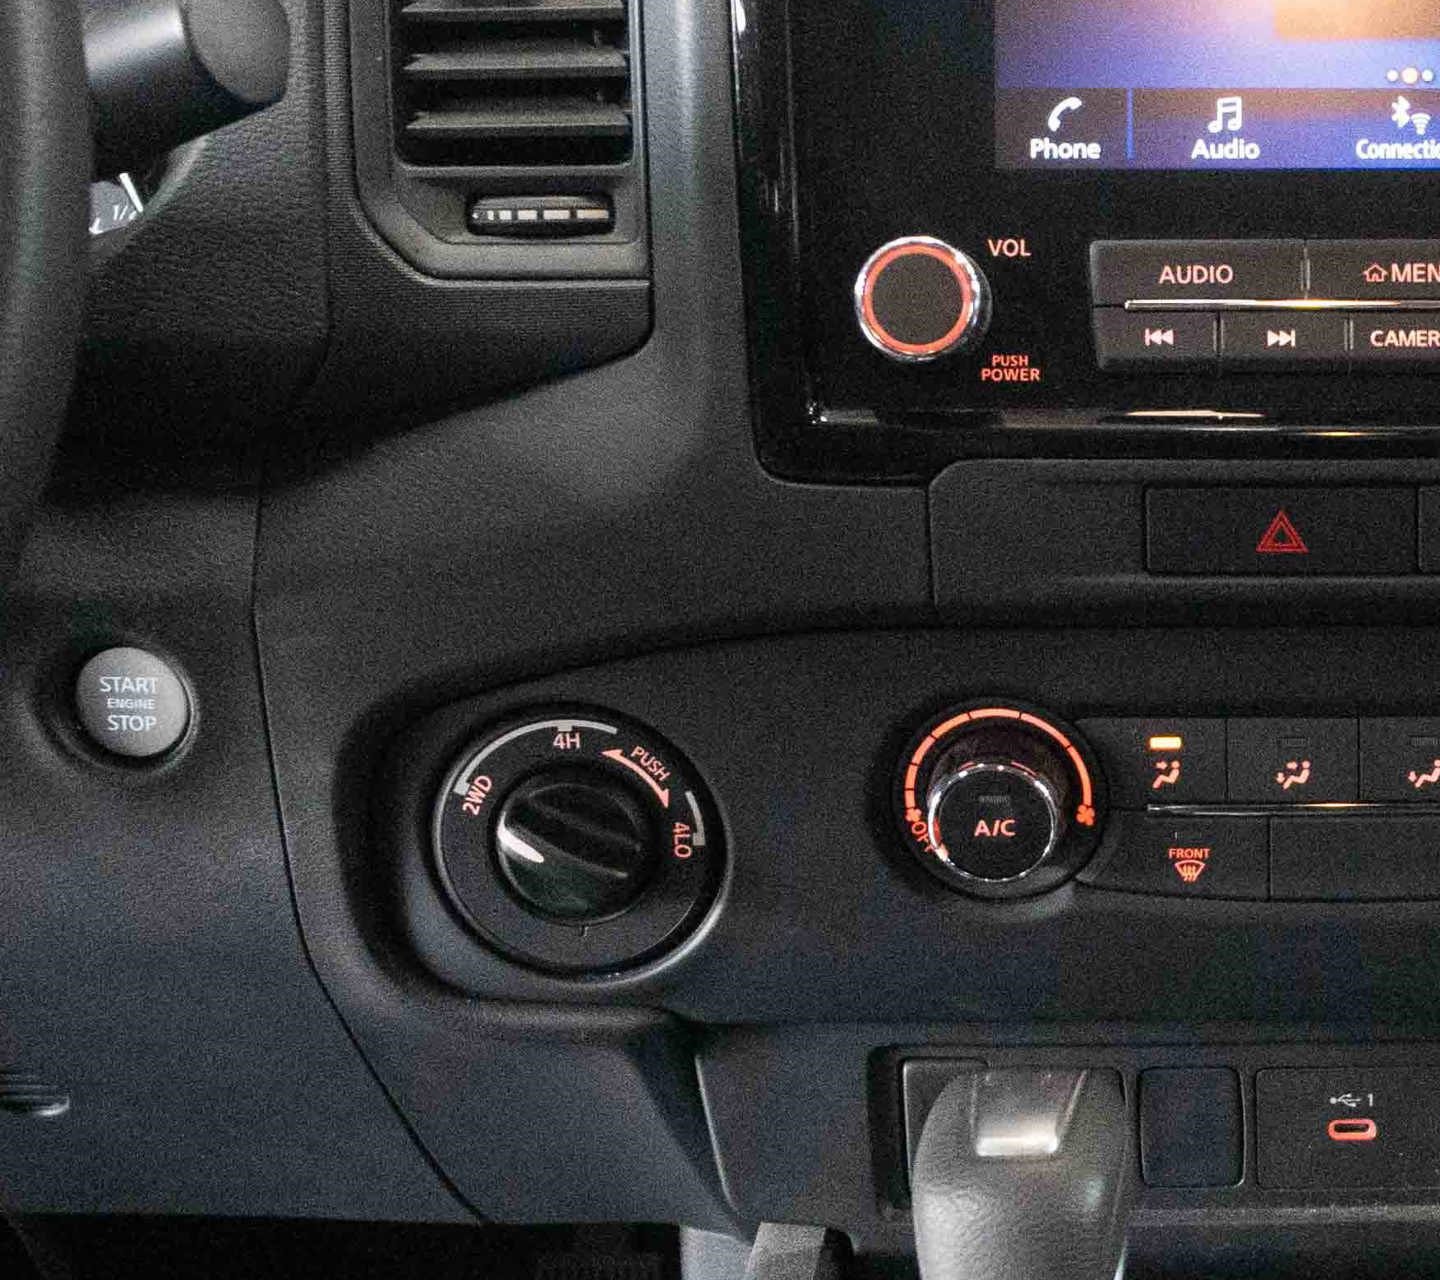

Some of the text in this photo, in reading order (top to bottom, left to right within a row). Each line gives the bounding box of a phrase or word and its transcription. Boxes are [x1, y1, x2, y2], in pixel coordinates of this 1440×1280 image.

[1029, 136, 1102, 161] Phone
[1190, 137, 1261, 161] Audio
[987, 238, 1031, 258] VOL
[1158, 264, 1234, 285] AUDIO
[990, 355, 1030, 368] PUSH
[980, 367, 1041, 382] POWER
[99, 675, 160, 695] START
[106, 697, 157, 711] ENGINE
[107, 713, 159, 732] STOP
[552, 732, 581, 750] 4H
[629, 745, 672, 782] PUSH
[462, 775, 493, 816] 2WD
[974, 819, 1016, 837] A/C
[672, 821, 693, 859] 4LO
[1168, 847, 1210, 860] FRONT
[1367, 1093, 1375, 1107] 1
